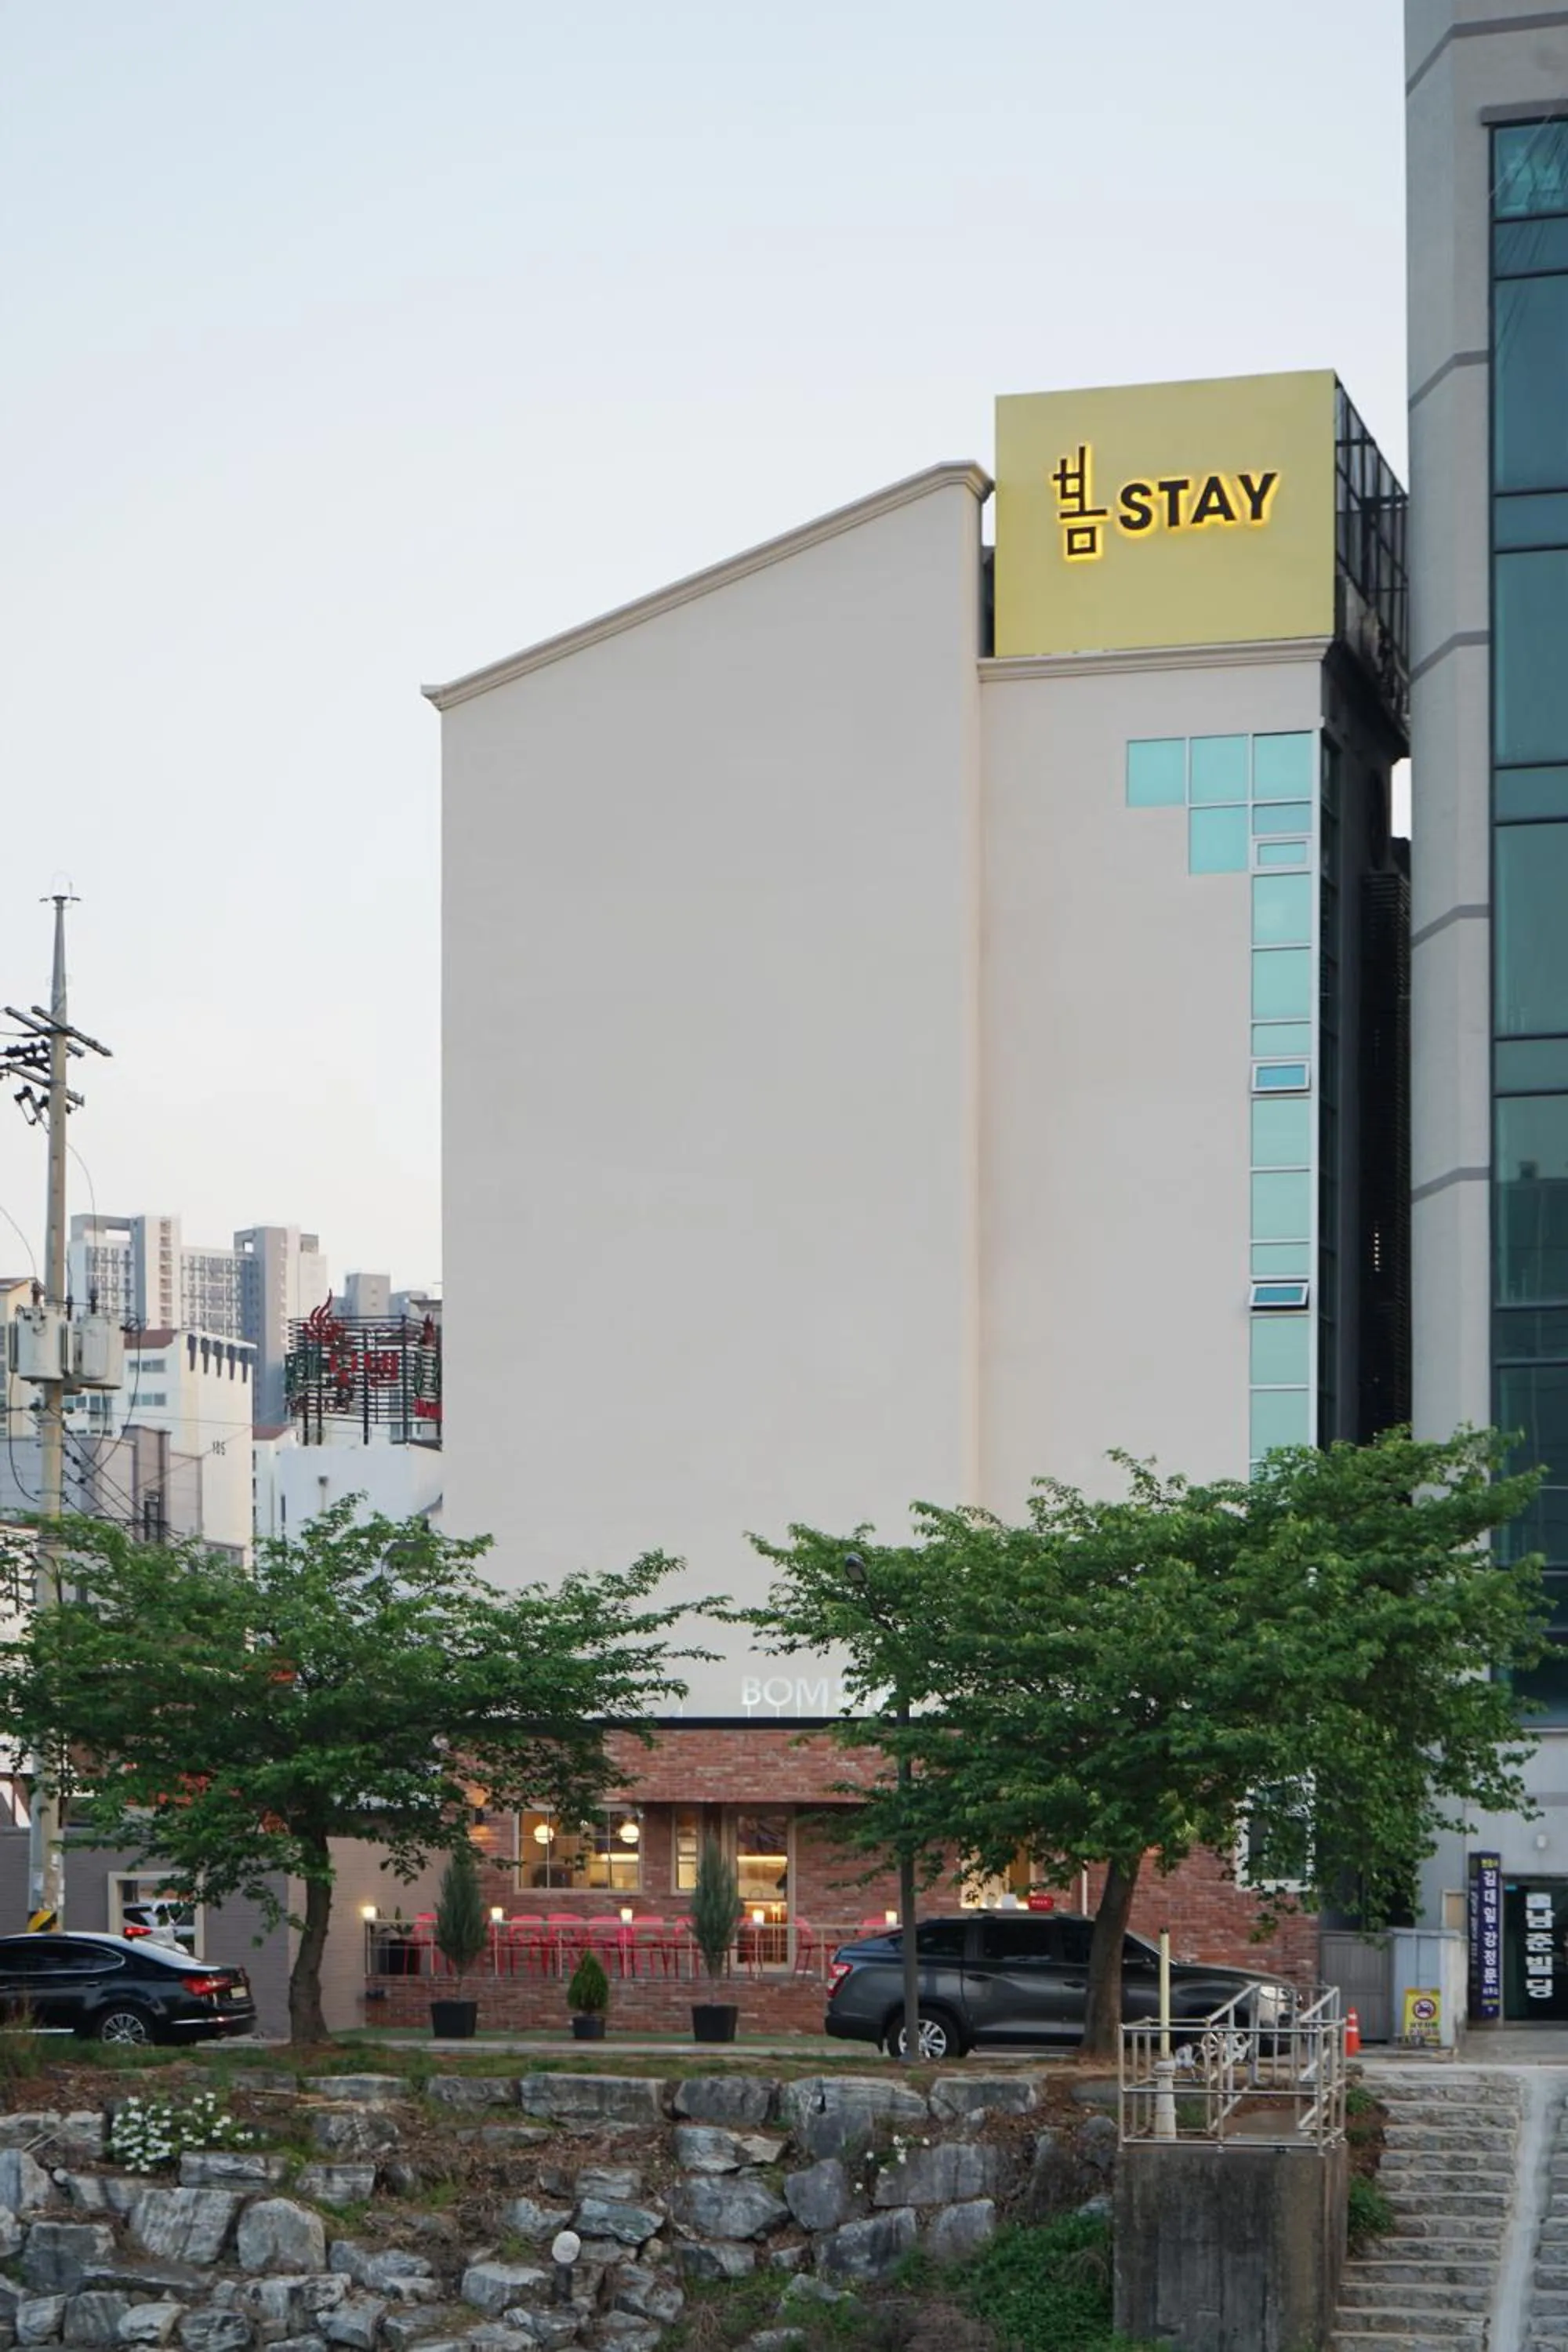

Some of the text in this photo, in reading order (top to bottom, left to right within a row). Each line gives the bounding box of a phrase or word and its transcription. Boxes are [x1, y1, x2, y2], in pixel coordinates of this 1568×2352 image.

[1053, 445, 1279, 557] 봄 STAY
[741, 1676, 829, 1706] BOM
